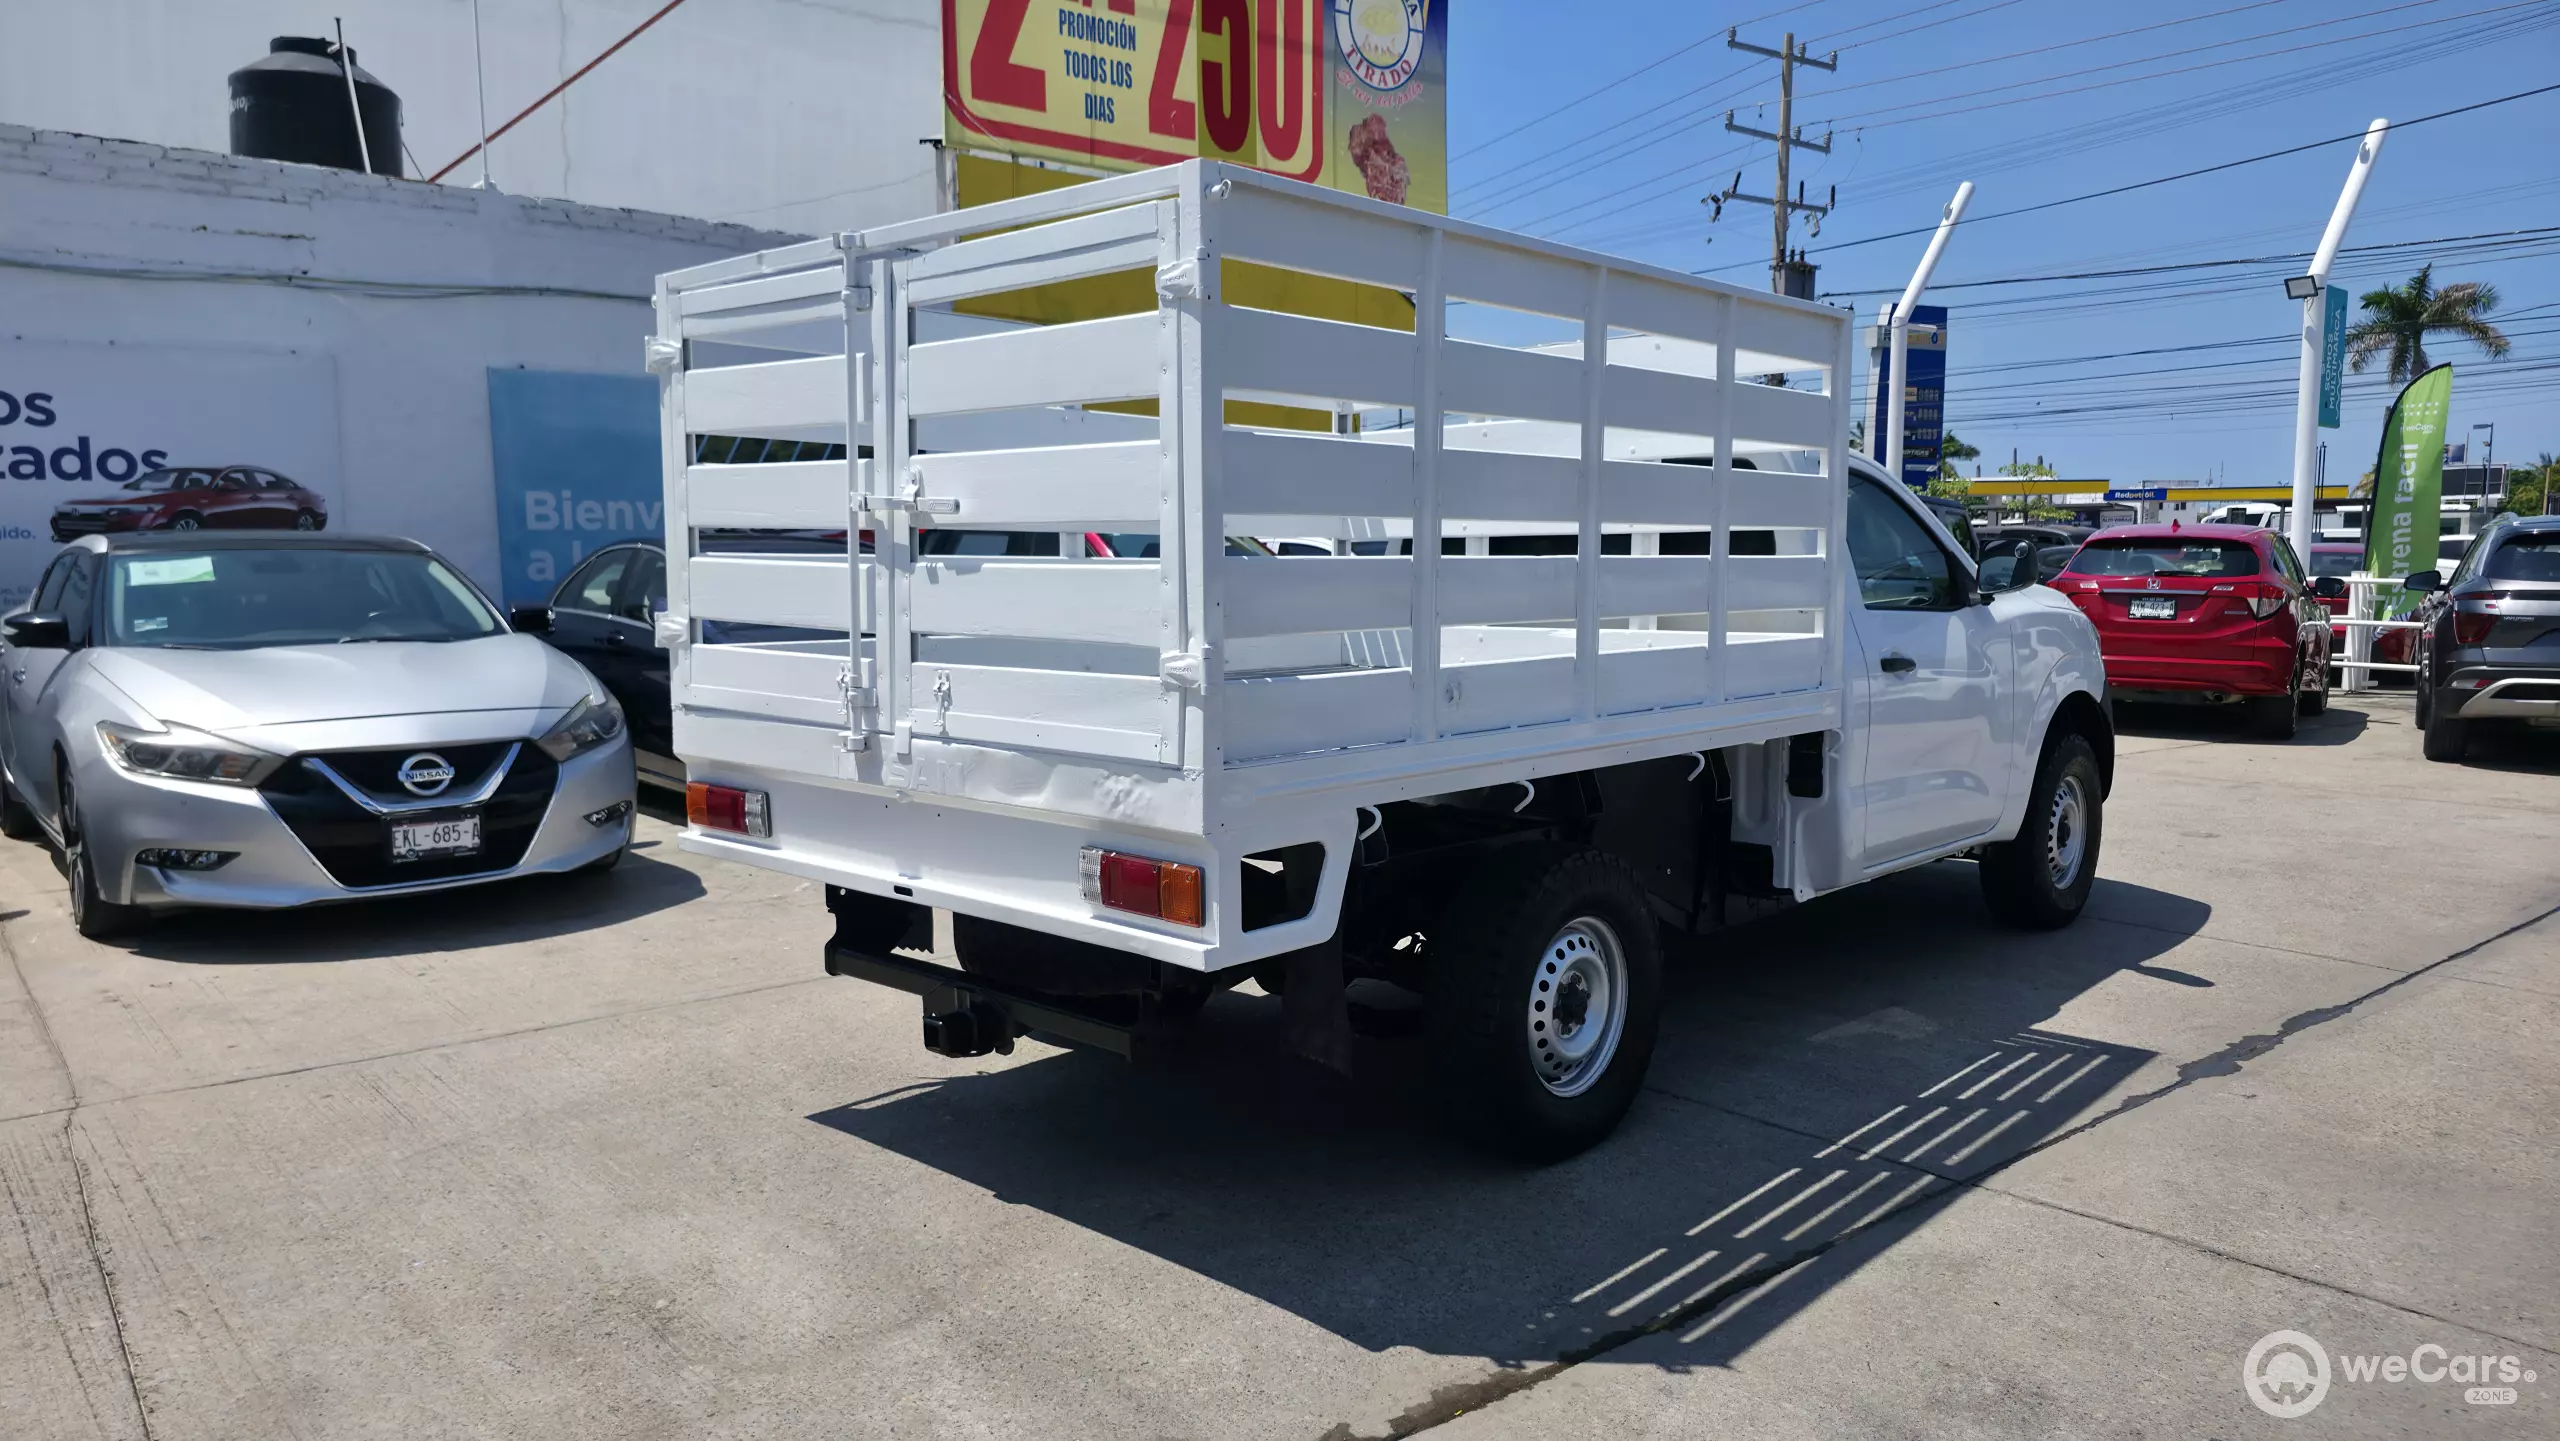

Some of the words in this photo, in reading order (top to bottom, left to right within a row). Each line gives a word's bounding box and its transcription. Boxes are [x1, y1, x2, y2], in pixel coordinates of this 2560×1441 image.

[1058, 8, 1137, 51] PROMOCIÓN
[1063, 49, 1107, 84] TODOS
[1109, 59, 1133, 89] LOS
[1345, 46, 1412, 87] TIRADO
[1084, 92, 1115, 124] DIAS
[2324, 333, 2333, 391] SOMOS
[2328, 309, 2341, 409] MULTIMARCA
[0, 435, 168, 482] ados
[405, 769, 450, 780] NISSAN
[392, 822, 481, 850] EKL-685-A
